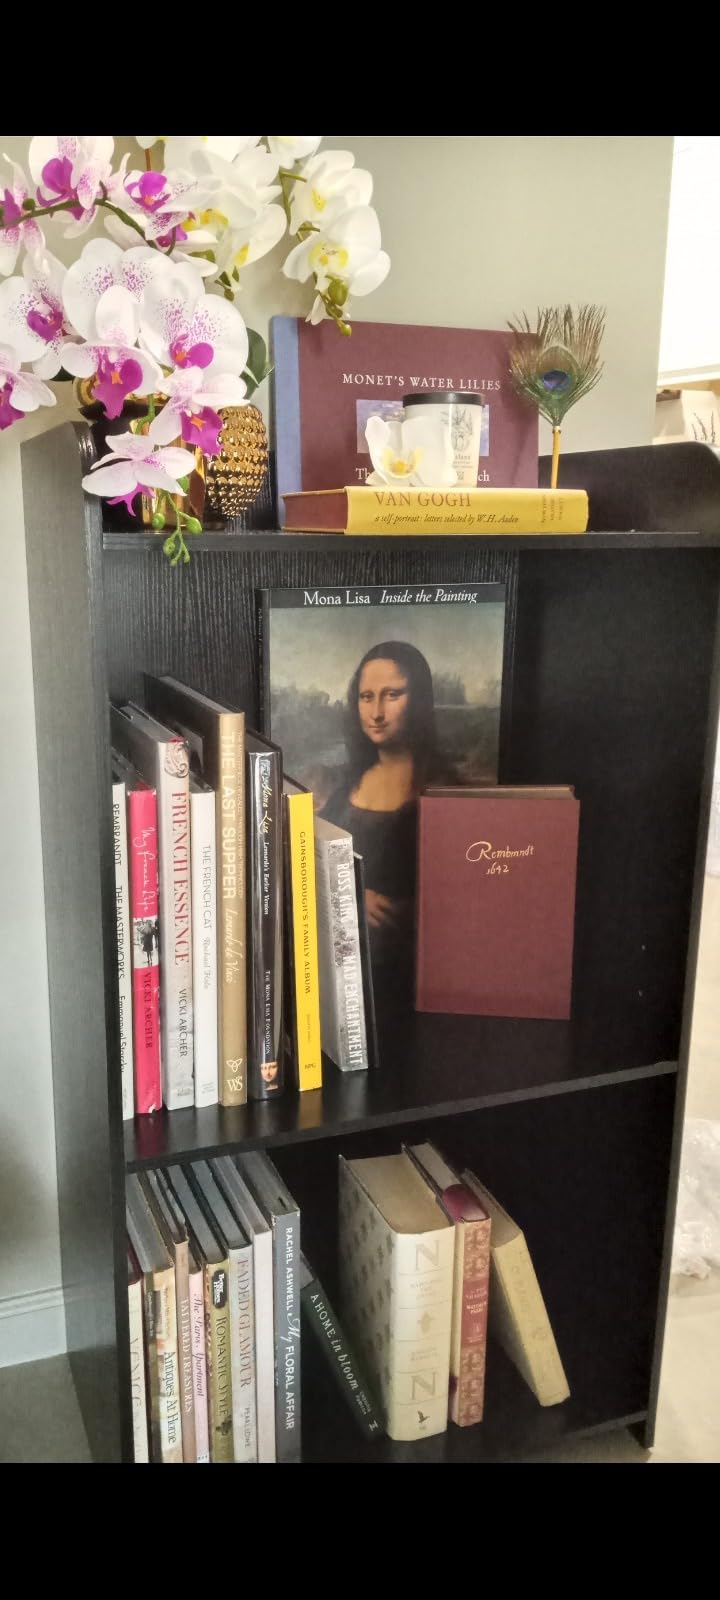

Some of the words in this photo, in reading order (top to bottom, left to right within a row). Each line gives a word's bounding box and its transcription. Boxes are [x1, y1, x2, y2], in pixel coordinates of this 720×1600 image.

[343, 373, 405, 387] MONET'S
[410, 376, 455, 389] WATER
[459, 378, 501, 391] LILIES
[355, 467, 371, 481] Th
[374, 491, 411, 506] VAN
[417, 491, 472, 507] GOGH
[444, 513, 467, 523] selected
[468, 513, 475, 525] by
[303, 590, 342, 606] Mona
[345, 590, 371, 605] Lisa
[380, 589, 413, 605] Inside
[415, 588, 432, 603] the
[434, 588, 479, 604] Painting
[220, 733, 235, 770] THE
[221, 775, 236, 821] LAST
[261, 781, 273, 808] Mona
[132, 826, 156, 848] My
[171, 792, 188, 873] FRENCH
[259, 810, 273, 835] Lisa
[201, 845, 211, 865] THE
[222, 829, 237, 899] SUPPER
[465, 840, 535, 862] Rembrandt
[299, 831, 309, 921] GAINSBOROUGH'S
[336, 862, 353, 892] ROSS
[485, 861, 510, 875] 1642
[115, 885, 123, 906] THE
[202, 867, 211, 908] FRENCH
[173, 878, 190, 966] ESSENCE
[203, 910, 212, 929] CAT
[339, 893, 354, 924] KING
[224, 907, 243, 947] Leonardo
[302, 923, 310, 959] FAMILY
[224, 947, 243, 960] da
[342, 955, 356, 980] MAD
[143, 971, 152, 1001] VICKI
[225, 960, 240, 984] Vinci
[303, 960, 311, 994] ALBUM
[178, 988, 187, 1016] VICKI
[144, 1004, 153, 1049] ARCHER
[179, 1018, 188, 1058] ARCHER
[344, 983, 363, 1065] ENCHANTMENT
[285, 1227, 293, 1265] RACHEL
[415, 1239, 440, 1271] N
[213, 1281, 221, 1303] Homes
[237, 1259, 250, 1311] FADED
[286, 1267, 294, 1311] ASHWELL
[193, 1293, 203, 1314] The
[181, 1298, 191, 1354] TATTERED
[193, 1316, 203, 1345] Paris
[279, 1315, 300, 1343] My
[215, 1316, 227, 1381] ROMANTIC
[239, 1312, 252, 1388] GLAMOUR
[310, 1294, 319, 1303] A
[315, 1302, 336, 1338] HOME
[331, 1339, 342, 1353] in
[337, 1353, 359, 1390] bloom
[164, 1351, 177, 1398] Antiques
[192, 1347, 205, 1398] Apartment
[285, 1346, 294, 1389] FLORAL
[183, 1356, 193, 1413] TREASURES
[411, 1371, 436, 1401] N
[167, 1399, 178, 1413] At
[218, 1384, 228, 1417] STYLE
[285, 1392, 295, 1430] AFFAIR
[168, 1414, 180, 1444] Home
